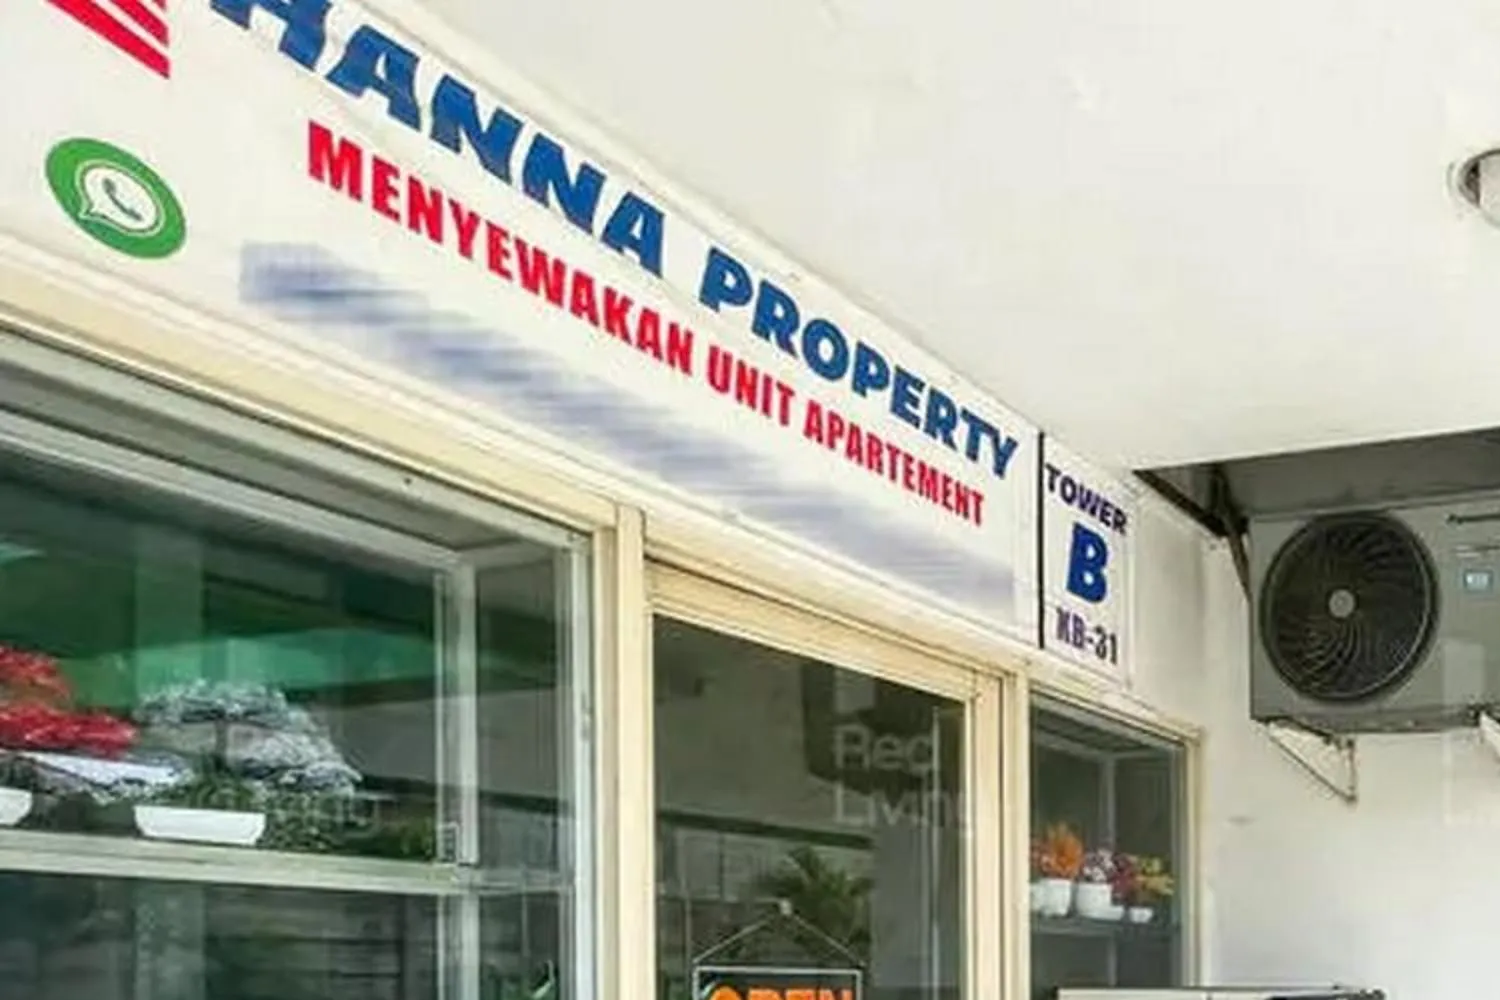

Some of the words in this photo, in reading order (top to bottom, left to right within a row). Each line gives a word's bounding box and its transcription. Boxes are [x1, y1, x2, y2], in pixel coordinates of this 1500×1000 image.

[206, 0, 664, 278] HANNA
[698, 246, 1019, 480] PROPERTY
[307, 119, 695, 377] MENYEWAKAN
[706, 344, 796, 427] UNIT
[803, 398, 986, 527] APARTEMENT
[1045, 463, 1128, 536] TOWER
[1065, 520, 1109, 604] B
